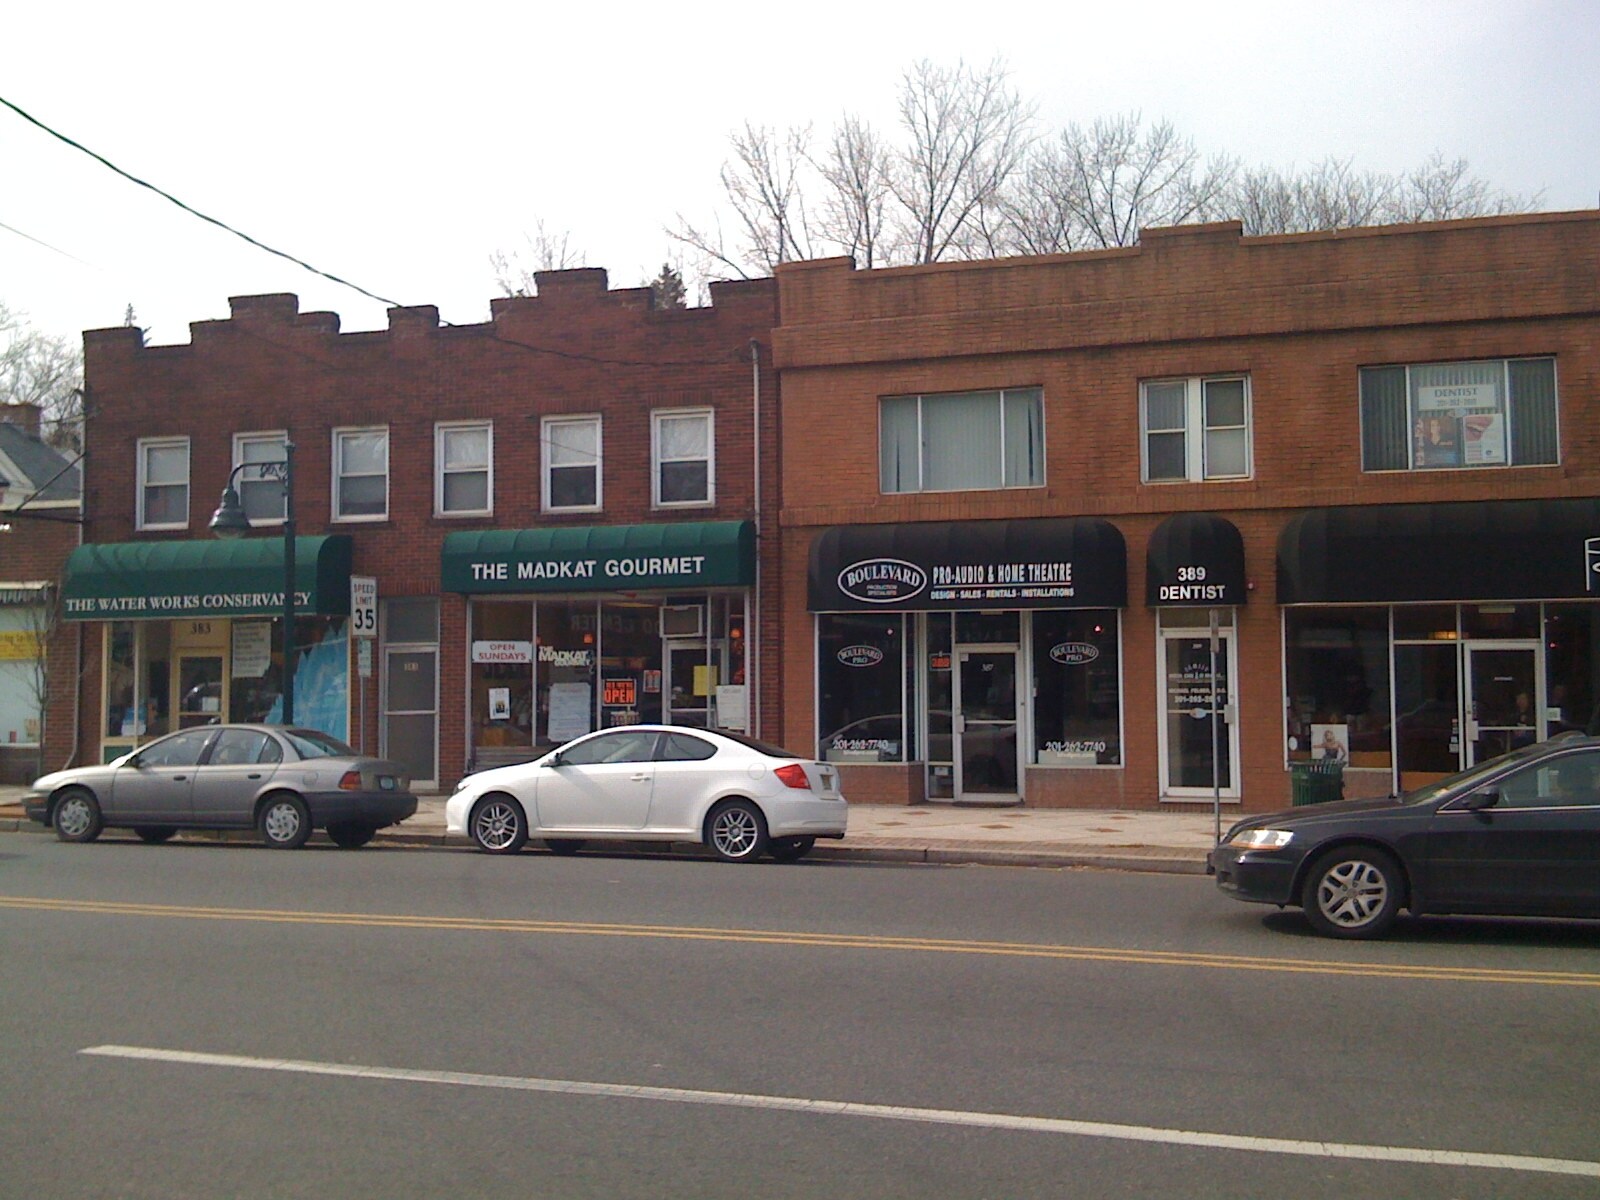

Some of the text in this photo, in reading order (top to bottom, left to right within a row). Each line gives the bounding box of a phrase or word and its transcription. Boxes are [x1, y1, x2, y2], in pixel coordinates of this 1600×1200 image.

[1434, 387, 1478, 398] DENTIST
[471, 556, 705, 580] THE MADKAT GOURMET
[988, 565, 995, 583] &
[998, 564, 1025, 583] HOME
[1027, 563, 1072, 582] THEATRE
[1177, 566, 1206, 581] 389
[847, 565, 921, 587] BOULEVARD
[353, 583, 375, 594] SPEED
[930, 587, 1075, 600] DESIGN SALES RENTALS INSTALLATIONS
[1159, 585, 1225, 600] DENTIST
[66, 598, 96, 612] THE
[98, 597, 147, 611] WATER
[150, 595, 200, 610] WORKS
[355, 596, 373, 606] LIMIT
[354, 608, 374, 630] 35
[191, 622, 211, 634] 383
[490, 643, 515, 651] OPEN
[840, 647, 880, 660] BOULEVARD
[1052, 644, 1096, 658] BOULEVARD
[478, 651, 527, 661] SUNDAYS
[1065, 653, 1083, 662] PRO
[603, 688, 634, 704] OPEN
